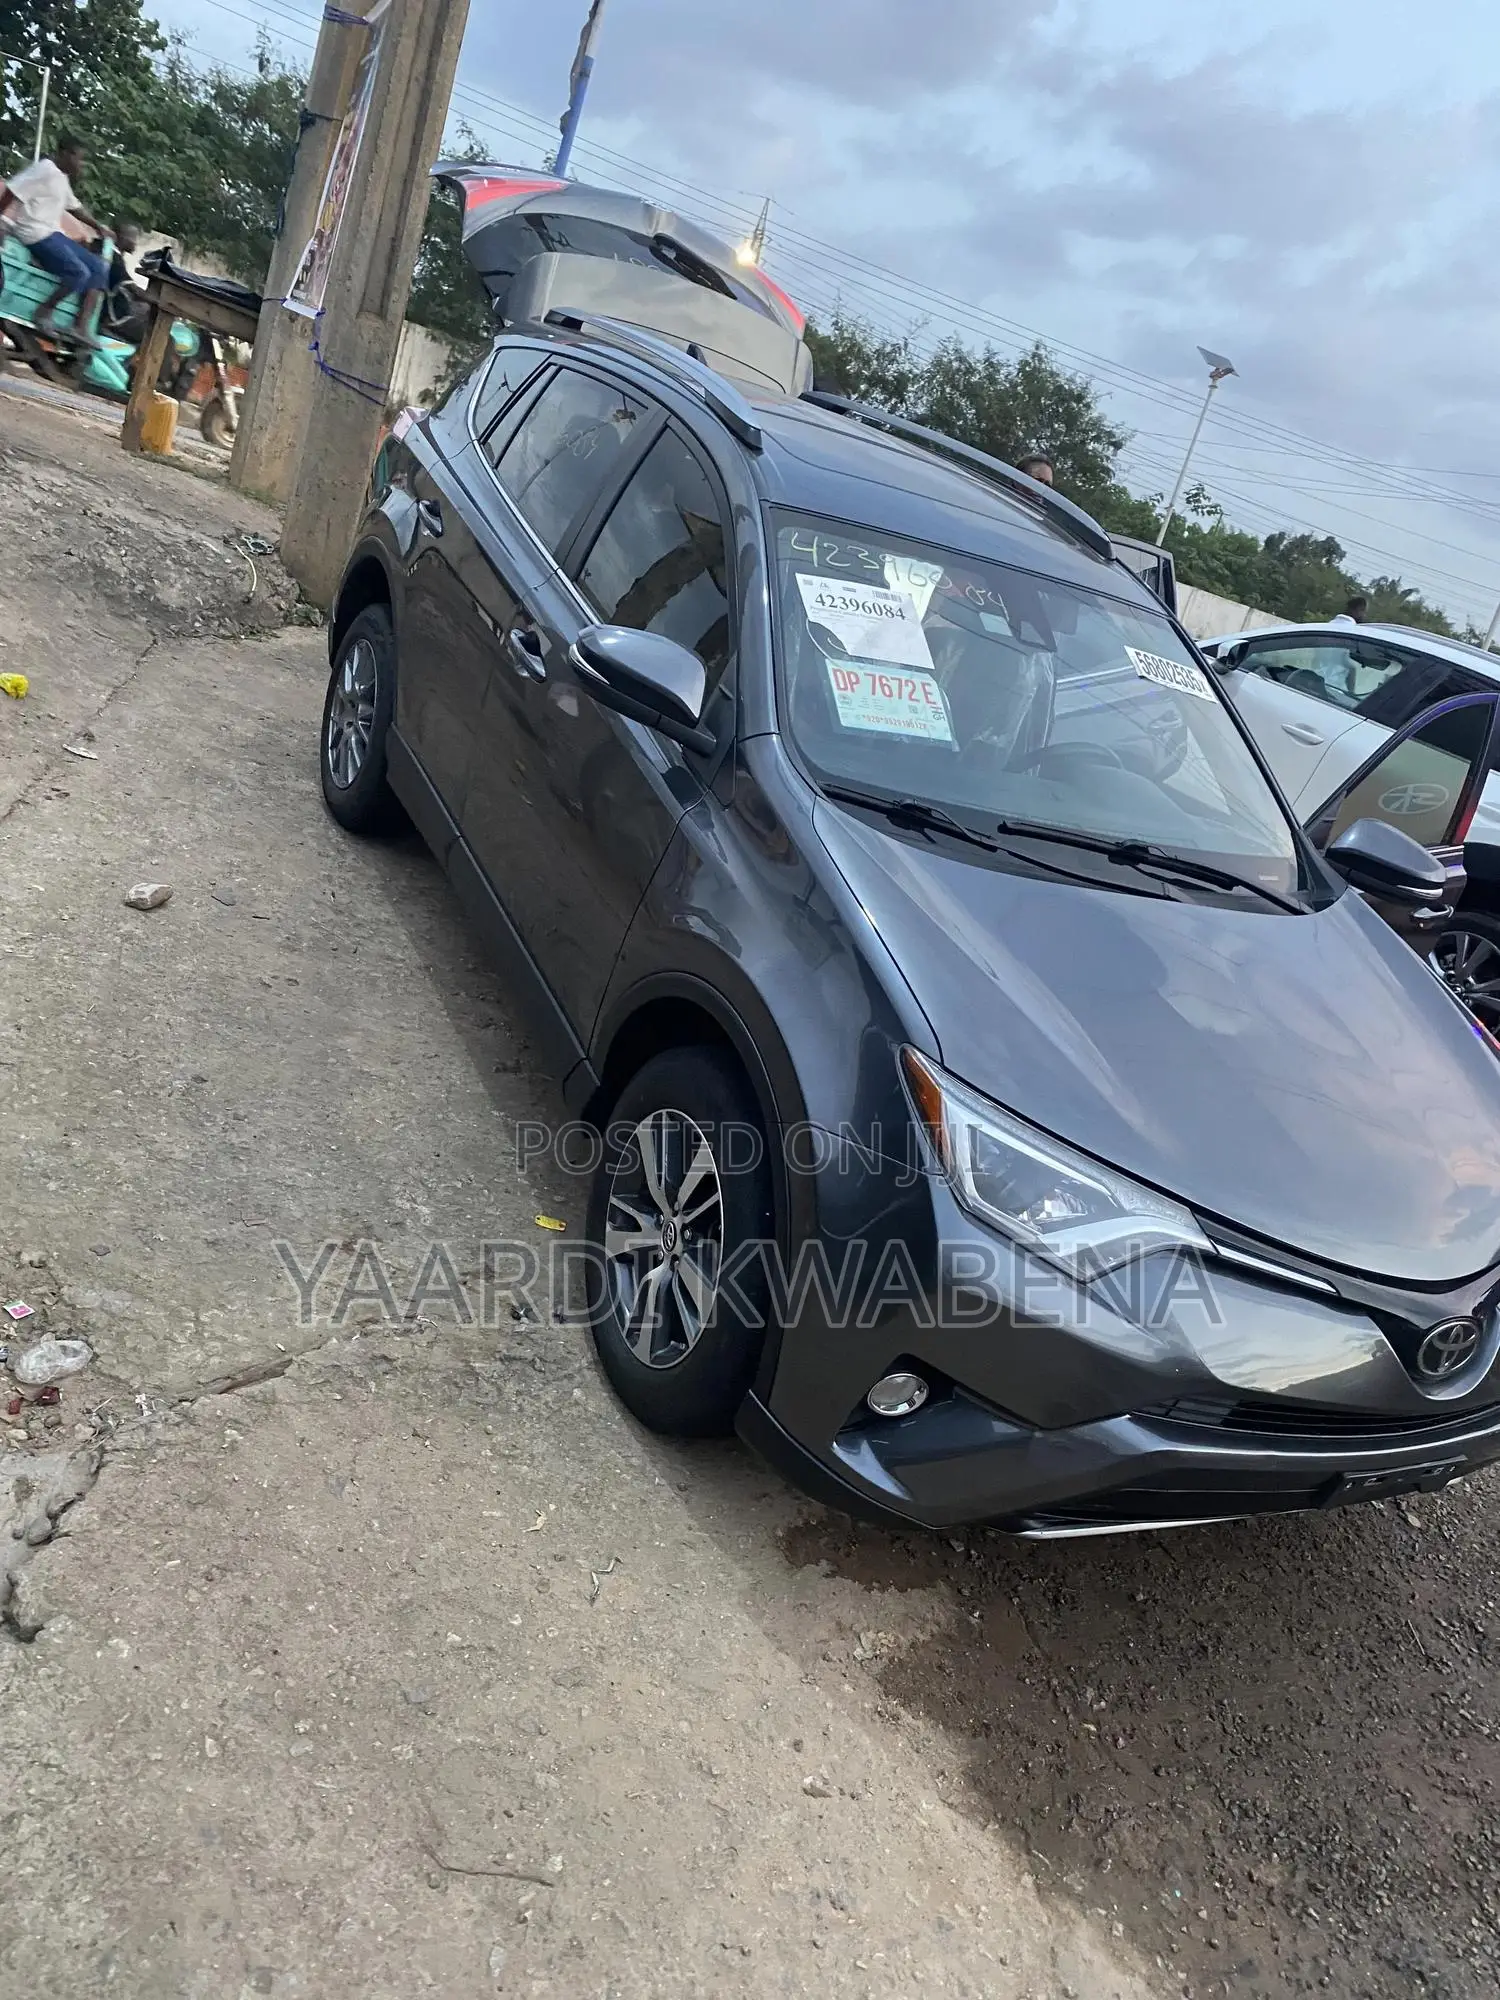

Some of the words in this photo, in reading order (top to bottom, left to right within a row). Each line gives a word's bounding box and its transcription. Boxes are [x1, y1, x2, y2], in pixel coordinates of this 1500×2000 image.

[815, 592, 906, 621] 42396084
[832, 668, 860, 693] DP
[864, 672, 921, 703] 7672
[921, 682, 937, 705] E
[932, 712, 946, 721] GH
